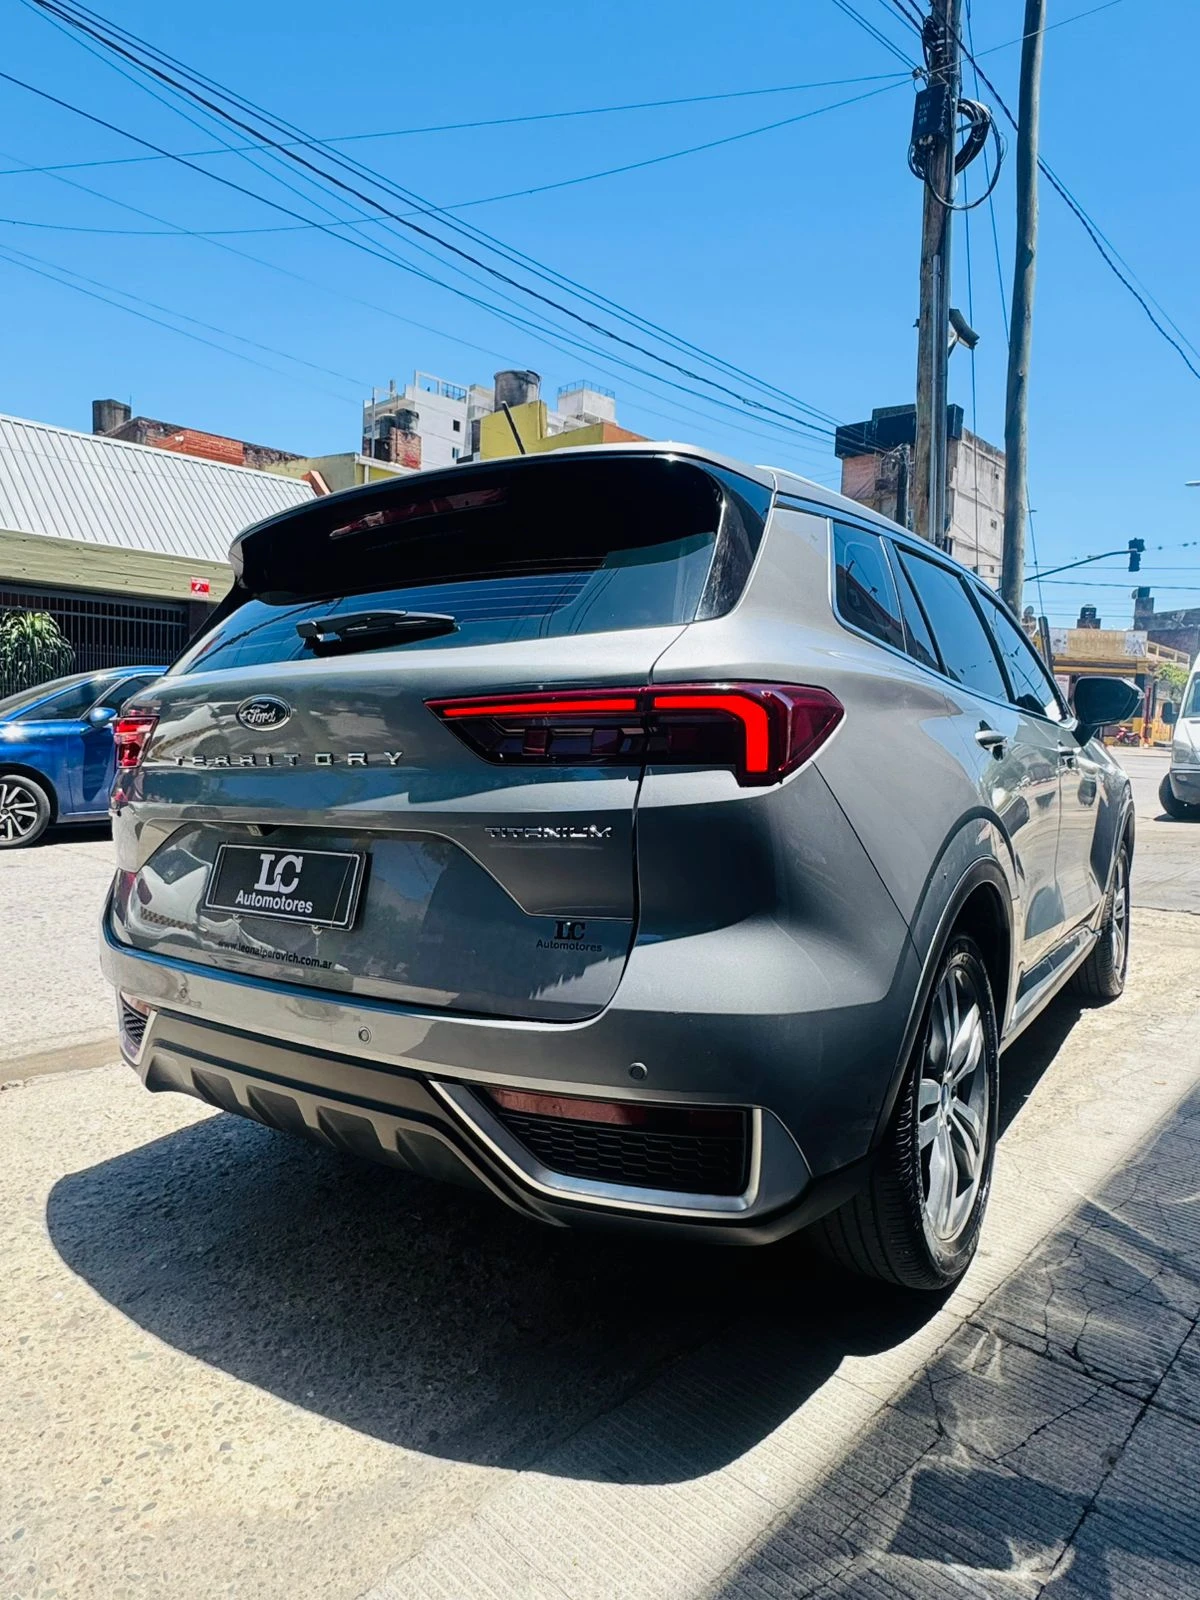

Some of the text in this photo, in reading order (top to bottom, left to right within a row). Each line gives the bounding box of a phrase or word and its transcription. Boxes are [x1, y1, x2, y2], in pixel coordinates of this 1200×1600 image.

[239, 703, 278, 724] Ford
[175, 751, 403, 767] TERRITORY
[484, 825, 613, 838] TITANIUM
[254, 853, 304, 894] LC
[235, 889, 314, 914] Automotores
[536, 938, 603, 953] Automotores
